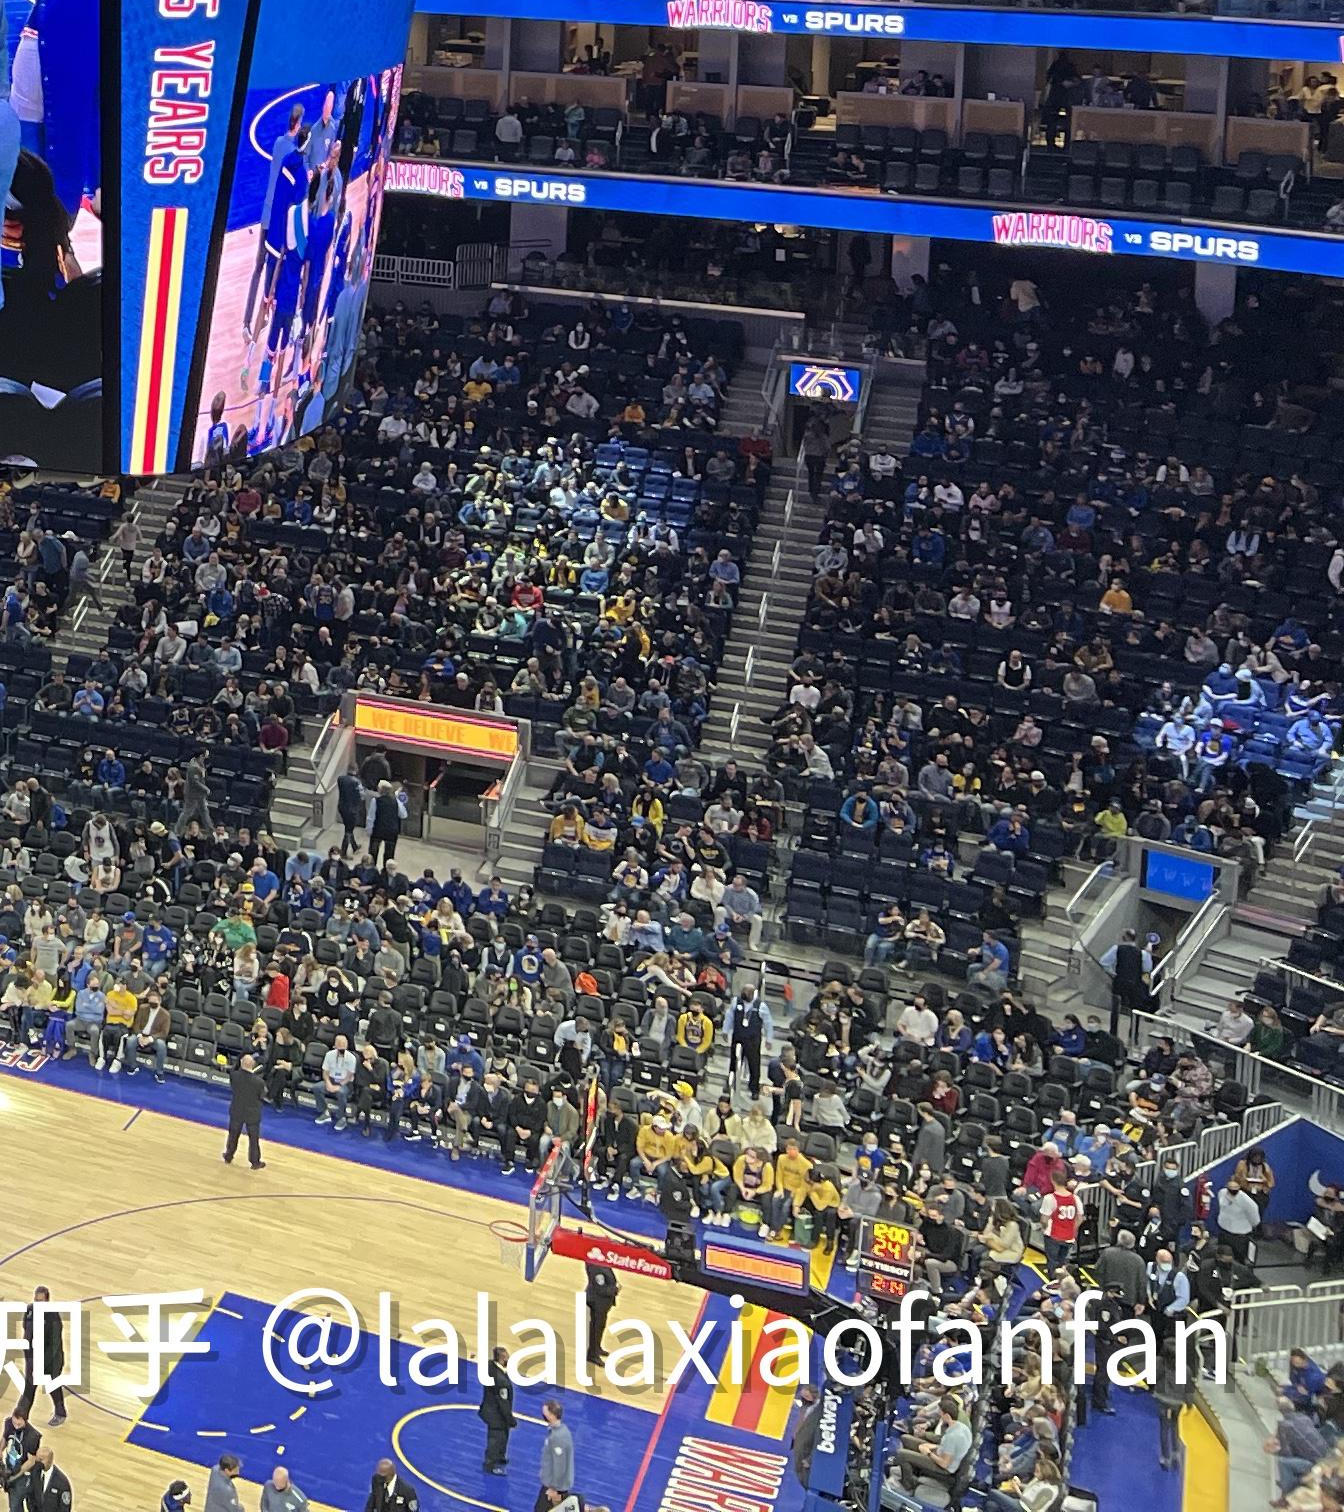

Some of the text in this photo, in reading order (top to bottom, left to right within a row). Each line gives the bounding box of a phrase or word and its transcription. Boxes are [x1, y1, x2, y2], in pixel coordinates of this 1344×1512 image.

[805, 9, 905, 35] SPURS
[143, 40, 215, 185] YEARS
[992, 211, 1113, 253] WARRIORS
[1148, 231, 1260, 261] SPURS
[1057, 1205, 1076, 1220] 30
[871, 1239, 902, 1260] 24
[605, 1250, 669, 1278] State Farm
[816, 1388, 843, 1455] betway
